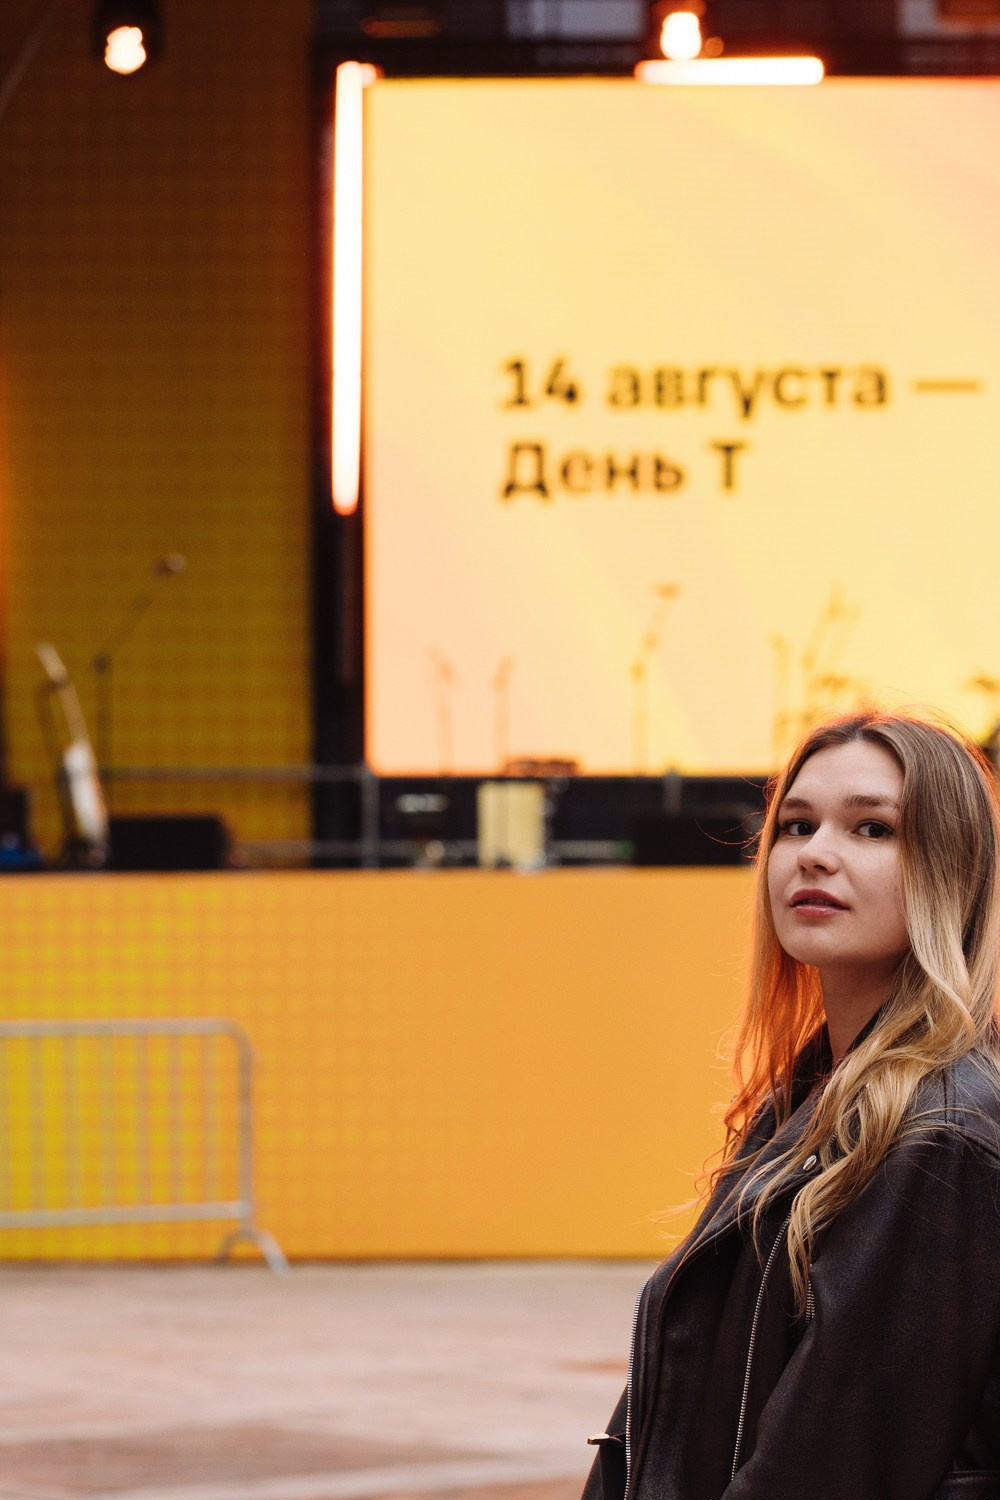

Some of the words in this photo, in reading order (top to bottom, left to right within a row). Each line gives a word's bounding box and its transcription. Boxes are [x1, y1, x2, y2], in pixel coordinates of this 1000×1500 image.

[503, 358, 580, 410] 14
[606, 363, 890, 419] августа
[502, 441, 686, 502] День
[709, 441, 748, 491] Т
